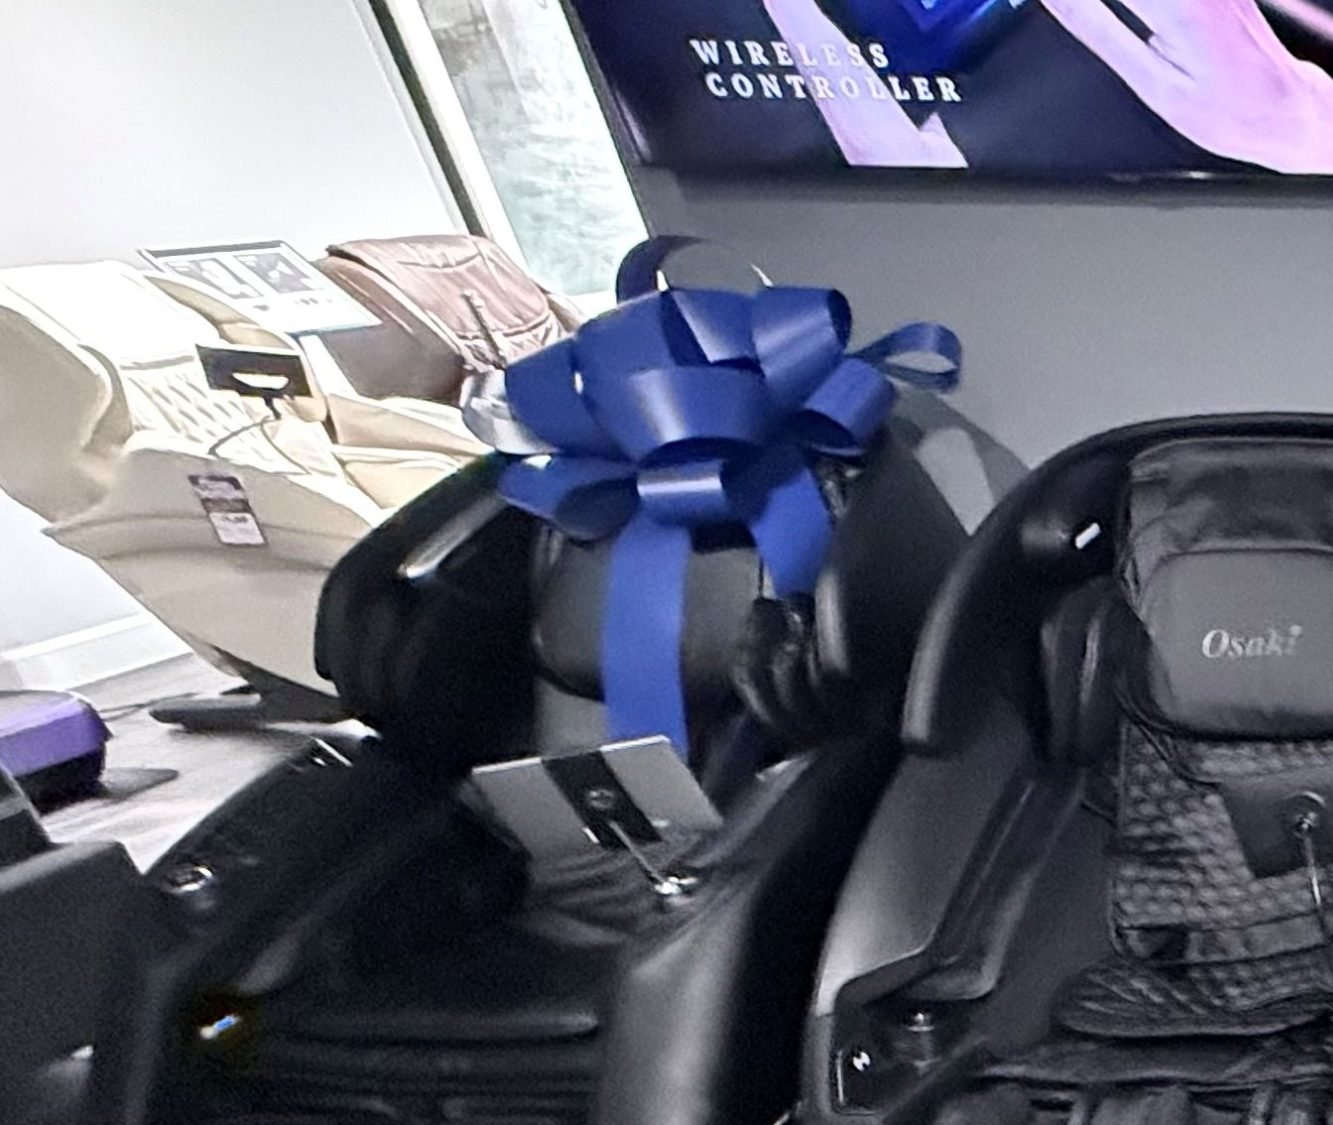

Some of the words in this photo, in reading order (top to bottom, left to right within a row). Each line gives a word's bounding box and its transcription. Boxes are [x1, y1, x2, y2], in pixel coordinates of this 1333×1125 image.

[689, 39, 889, 68] WIRELESS
[705, 72, 962, 102] CONTROLLER
[1202, 624, 1301, 658] Osaki
